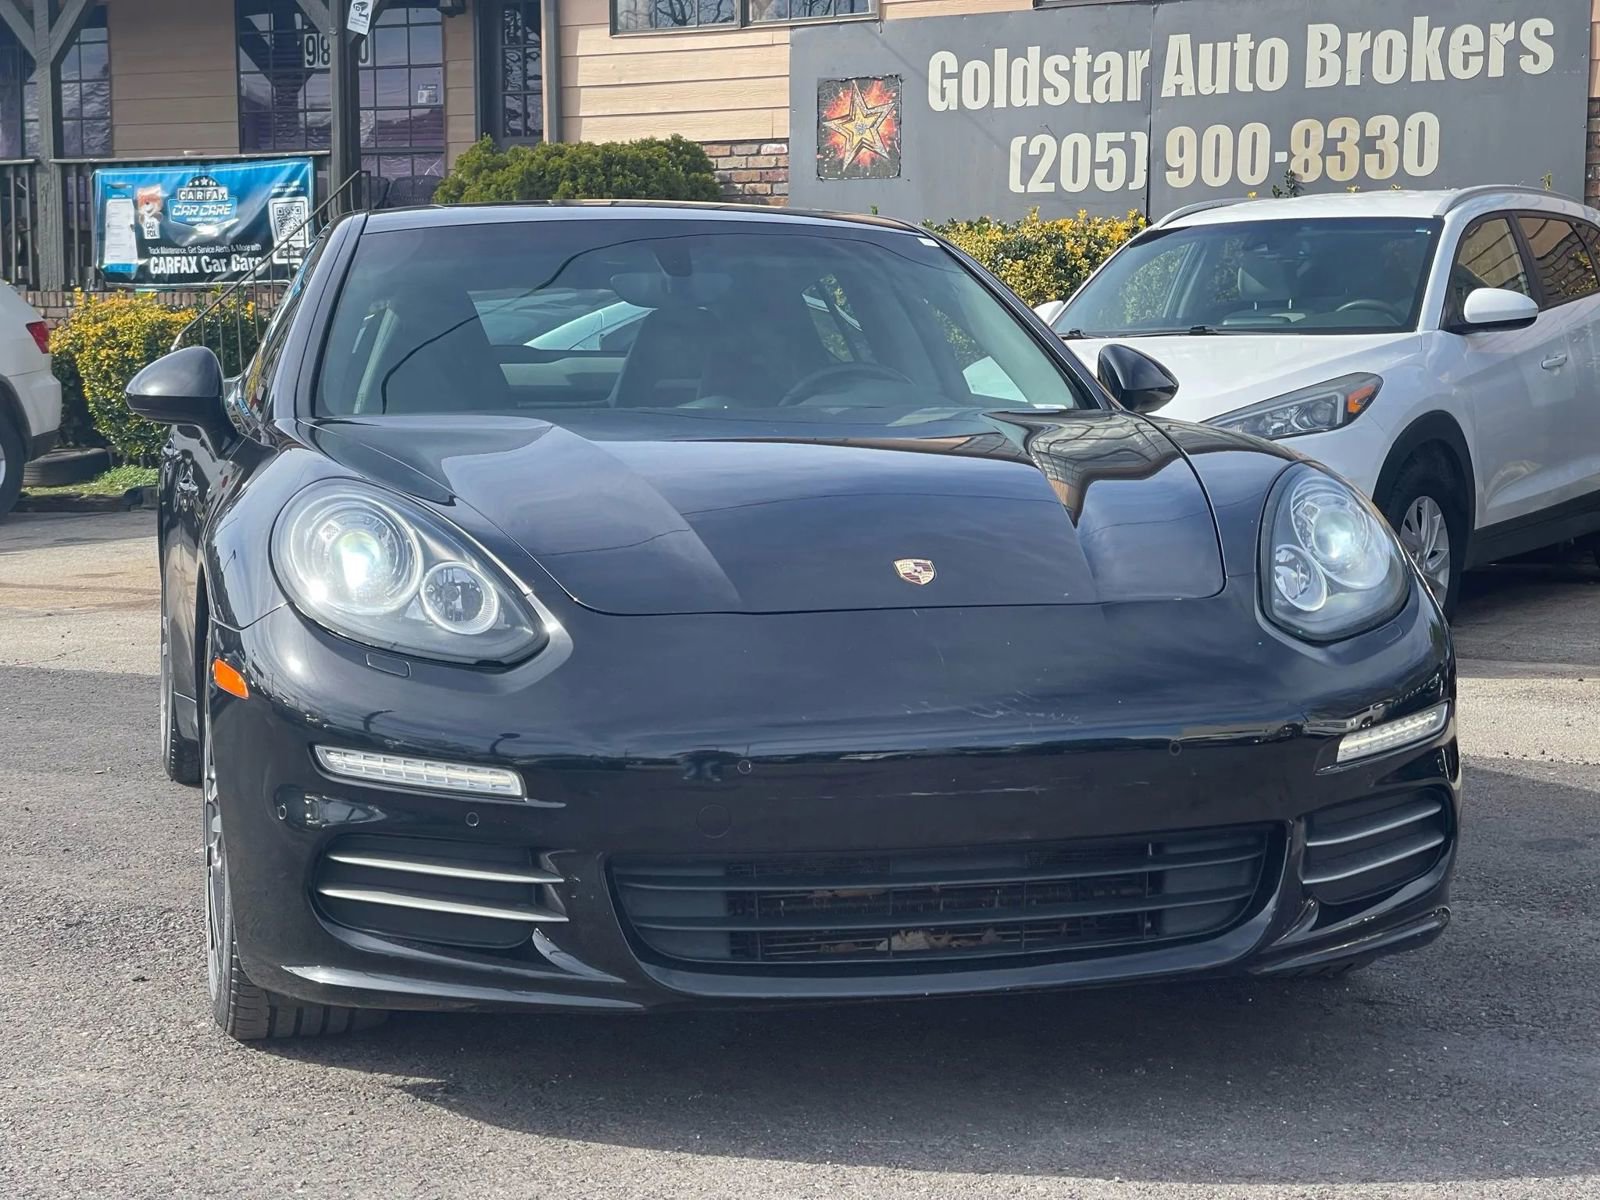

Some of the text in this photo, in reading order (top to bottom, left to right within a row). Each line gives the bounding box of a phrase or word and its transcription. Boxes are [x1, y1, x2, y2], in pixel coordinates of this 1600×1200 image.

[927, 16, 1555, 112] Goldstar Auto Brokers
[1008, 111, 1440, 193] (205) 900-8330
[179, 189, 226, 201] CARFAX
[172, 203, 233, 216] CAR CARE
[187, 246, 197, 254] Get
[197, 245, 215, 254] Service
[149, 255, 199, 274] CARFAX
[201, 255, 227, 273] Car
